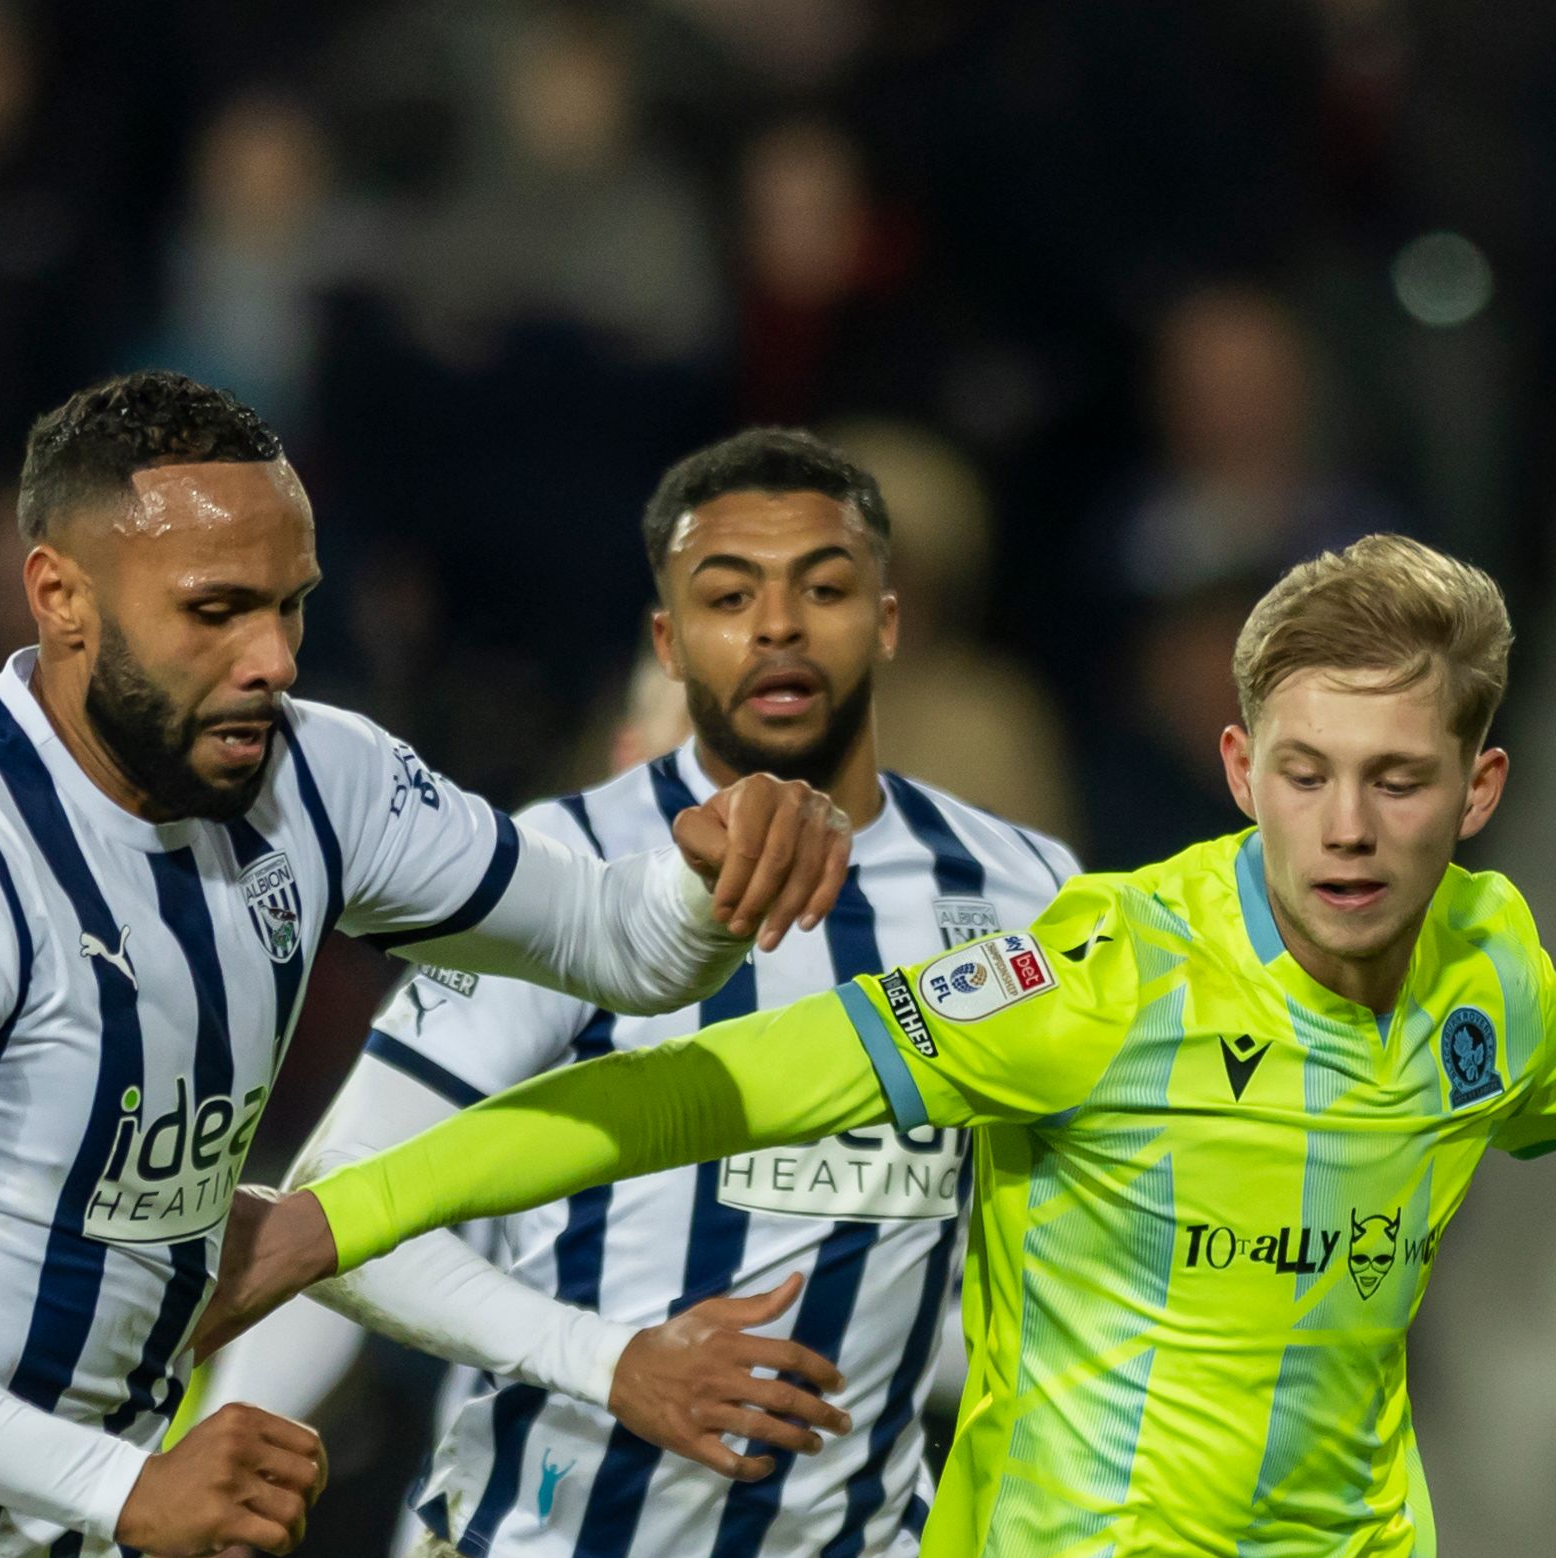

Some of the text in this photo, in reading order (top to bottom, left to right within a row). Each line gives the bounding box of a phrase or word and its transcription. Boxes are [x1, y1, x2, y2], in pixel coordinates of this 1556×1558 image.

[245, 865, 290, 900] ALBION
[1004, 936, 1040, 986] sky bet
[929, 975, 952, 1003] EFL
[104, 1077, 267, 1182] idea
[87, 1166, 236, 1221] HEATIN
